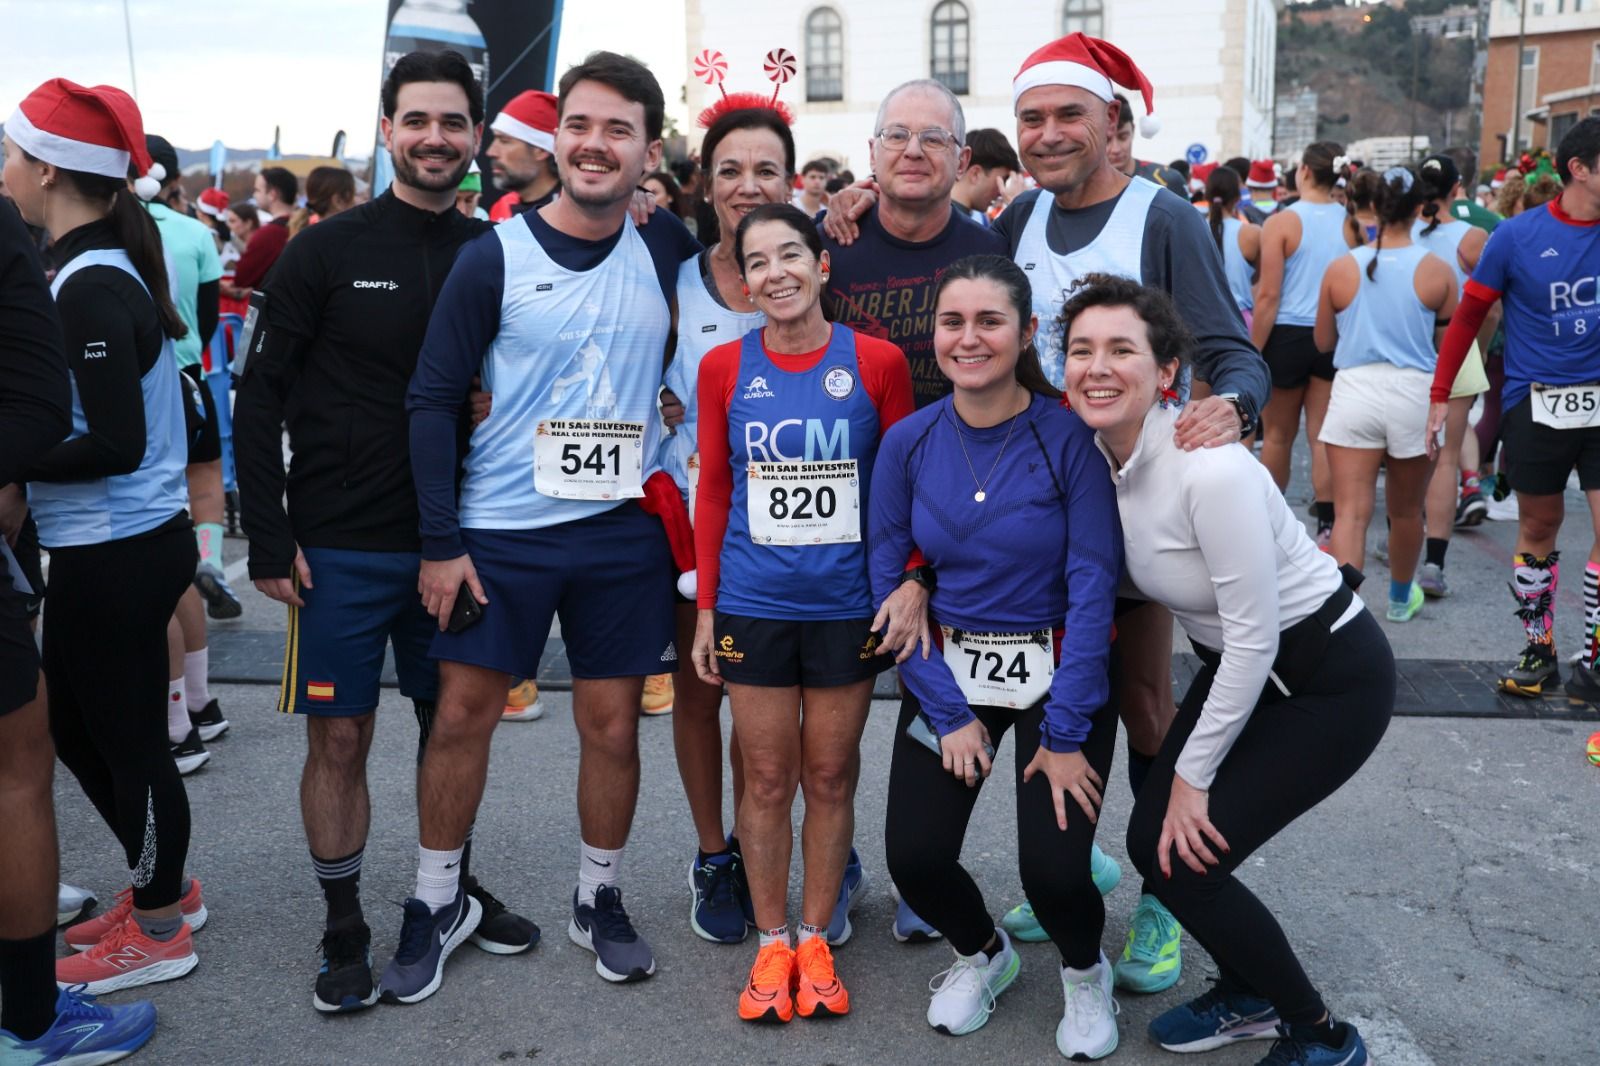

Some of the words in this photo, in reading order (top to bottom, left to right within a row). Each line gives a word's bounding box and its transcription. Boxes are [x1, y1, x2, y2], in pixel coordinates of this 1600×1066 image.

[353, 280, 389, 289] CRAFT
[1549, 275, 1600, 312] RC
[1547, 391, 1596, 415] 785
[569, 422, 590, 430] SAN
[593, 423, 644, 432] SILVESTRE
[745, 418, 850, 461] RCM
[561, 443, 620, 476] 541
[760, 465, 775, 473] VII
[777, 464, 798, 472] SAN
[802, 462, 856, 472] SILVESTRE
[769, 486, 836, 520] 820
[964, 648, 1030, 684] 724
